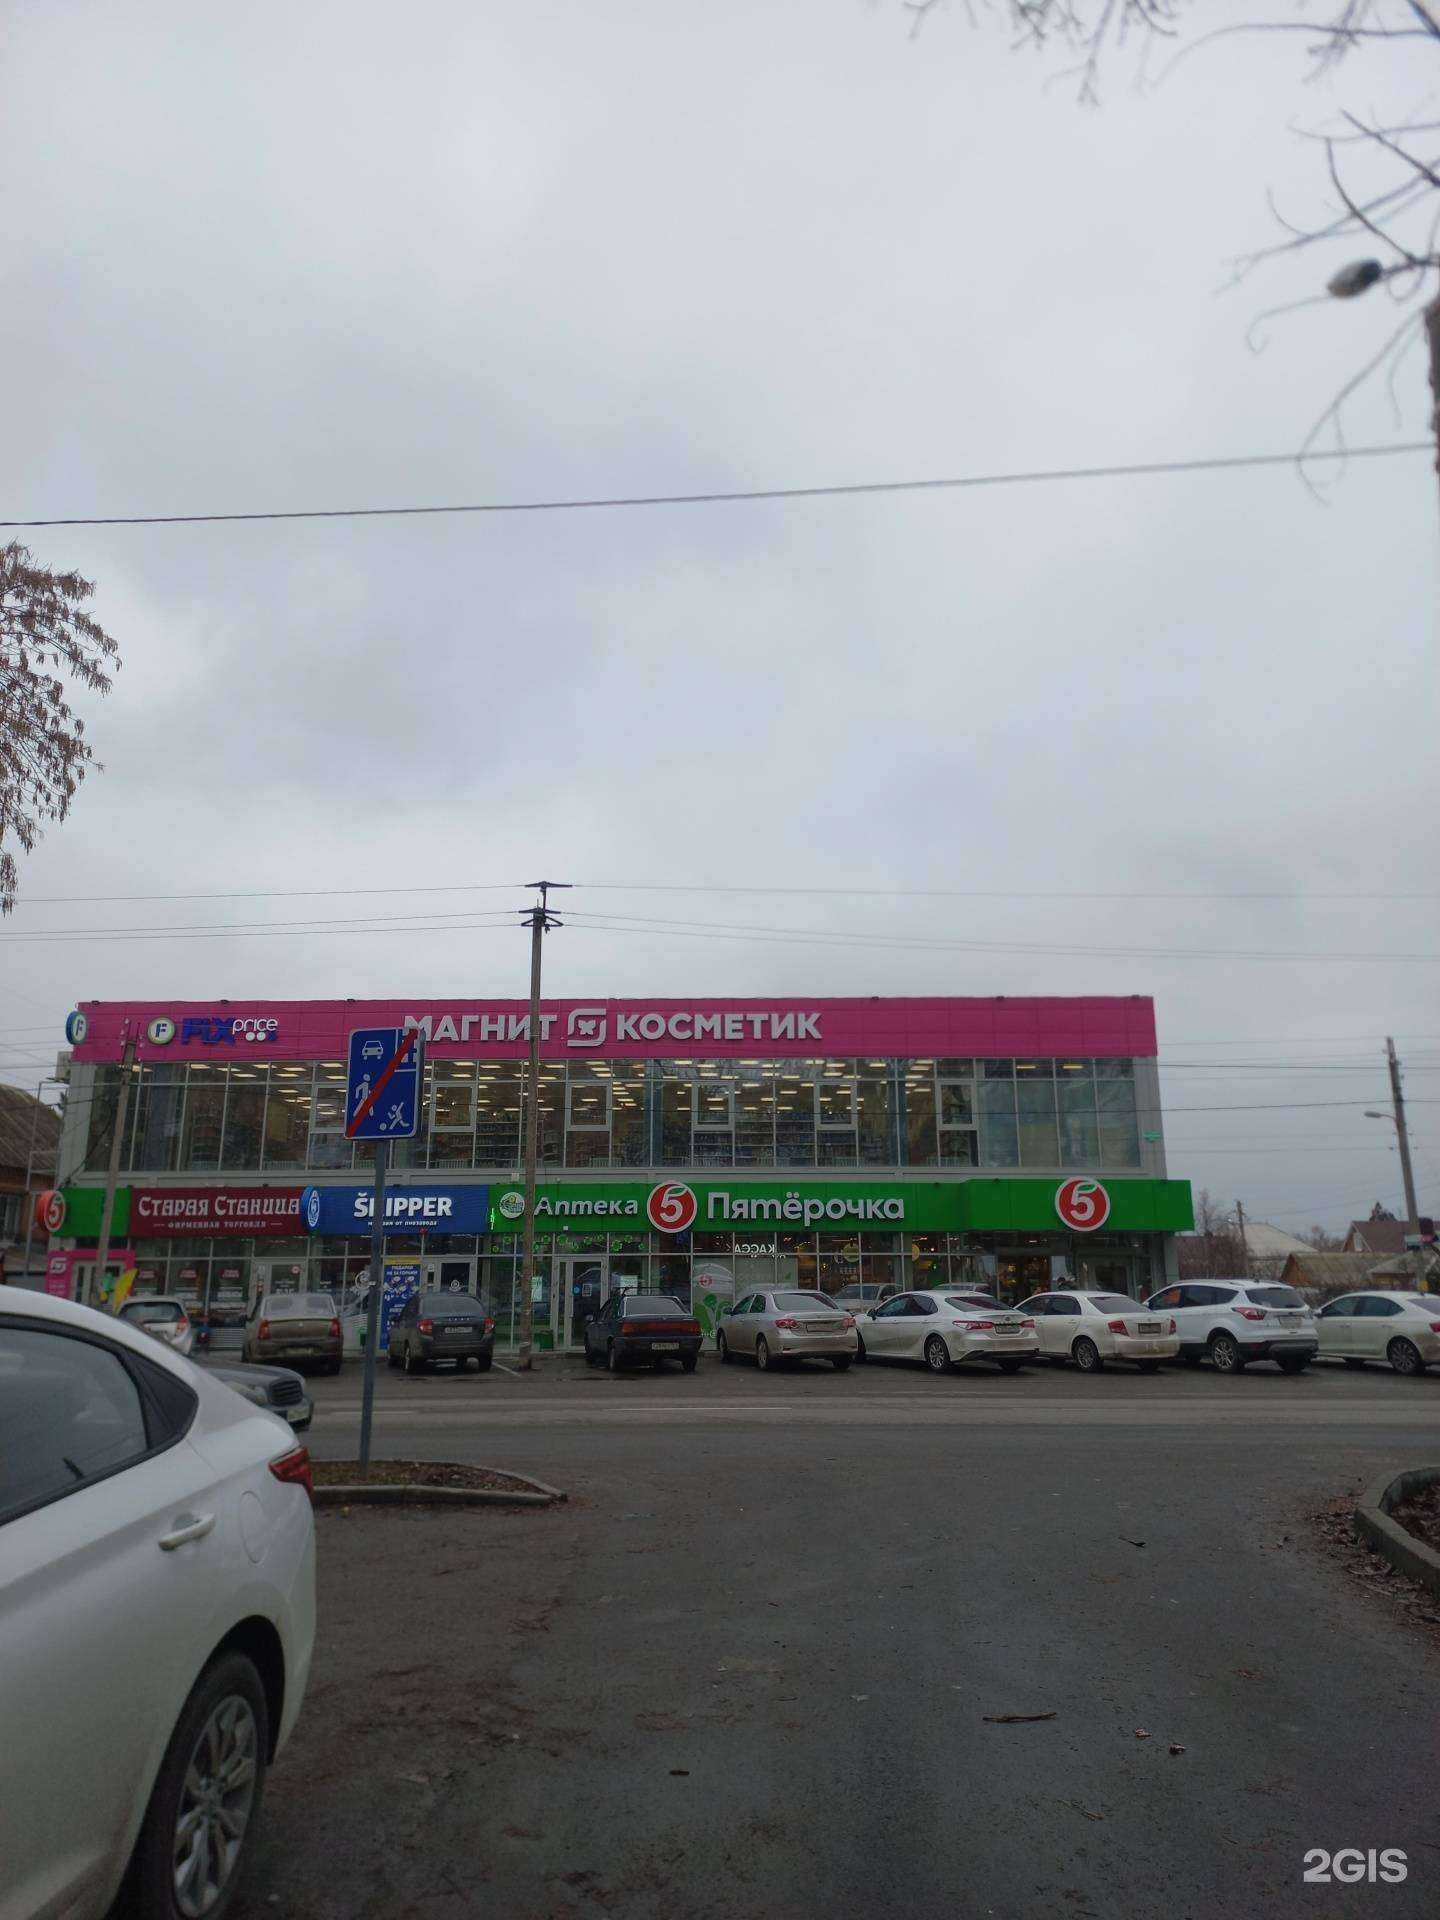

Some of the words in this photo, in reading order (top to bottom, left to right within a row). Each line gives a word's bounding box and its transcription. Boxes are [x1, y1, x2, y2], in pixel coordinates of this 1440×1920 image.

[232, 1015, 279, 1034] price
[403, 1014, 557, 1041] МАГНИТ
[617, 1012, 823, 1041] КОСМЕТИК
[533, 1196, 639, 1216] Аптека
[707, 1191, 905, 1227] Пятёрочка
